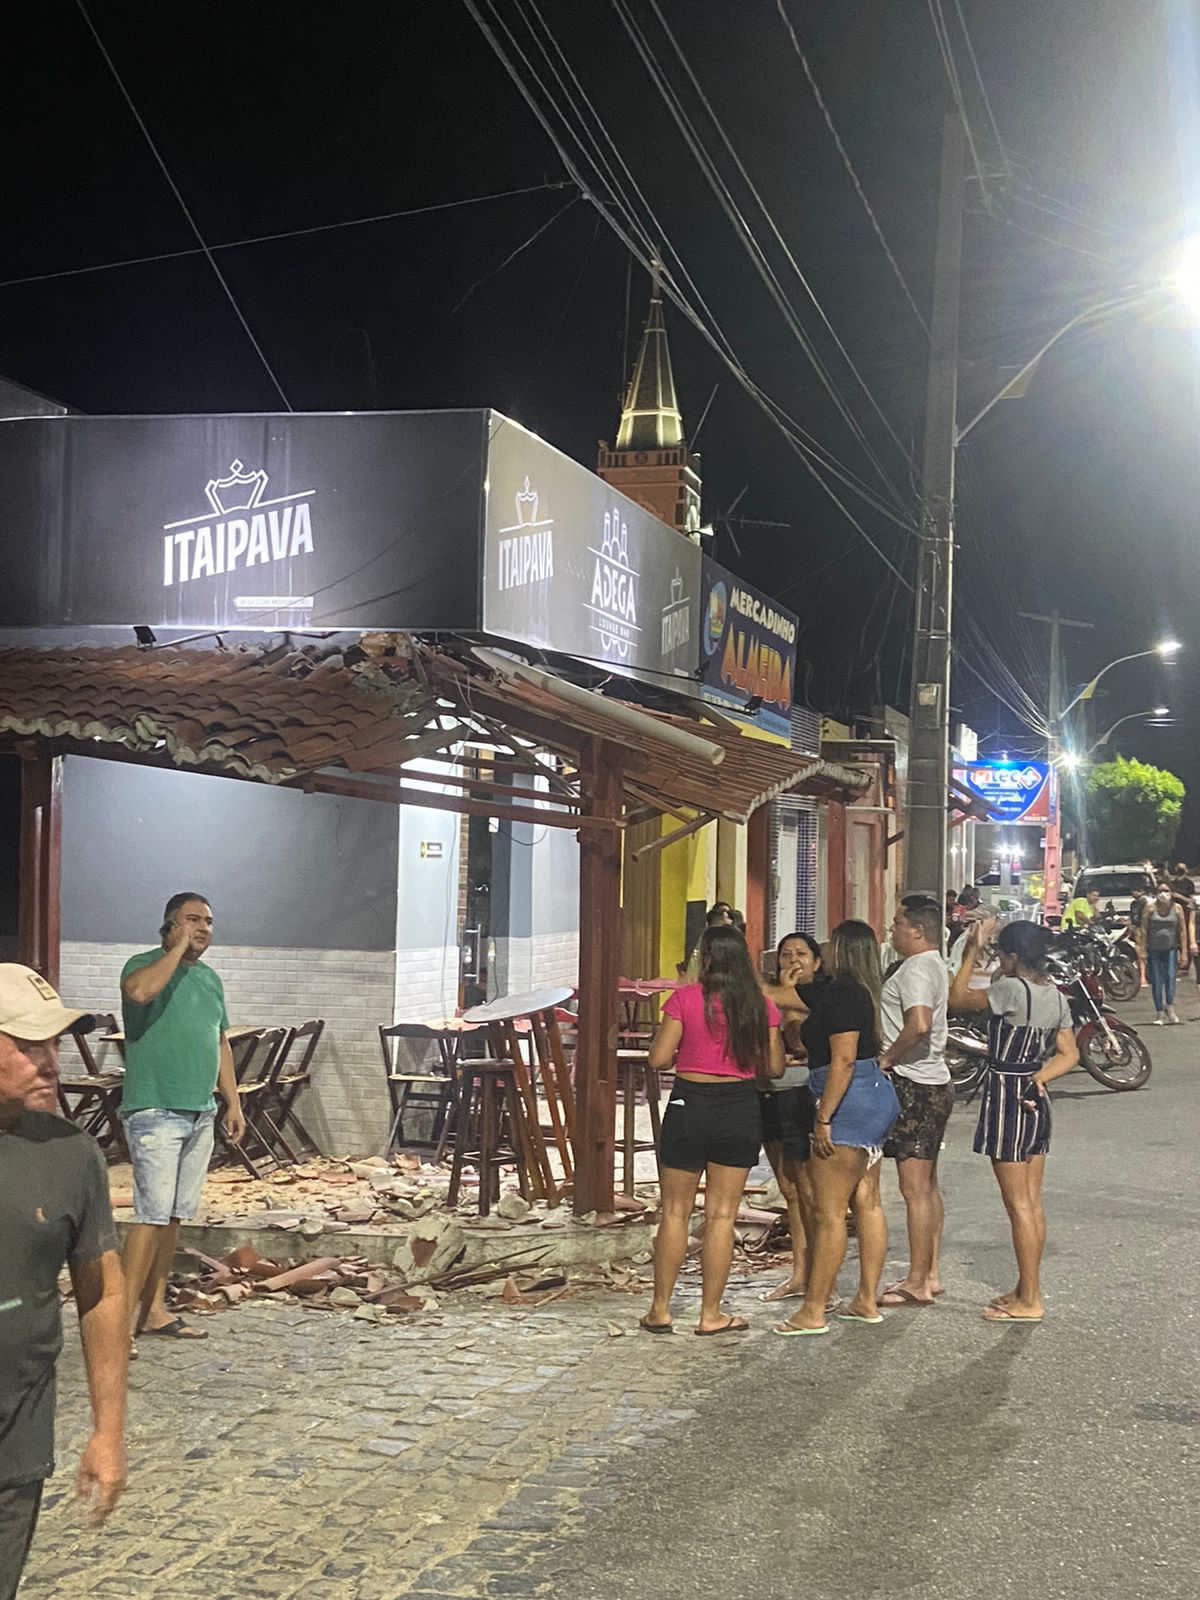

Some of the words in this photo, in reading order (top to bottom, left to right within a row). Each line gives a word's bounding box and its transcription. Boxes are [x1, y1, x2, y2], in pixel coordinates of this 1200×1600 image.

[163, 502, 314, 586] ITAIPAVA
[498, 530, 554, 591] ITAIPAVA
[591, 557, 637, 625] ADEGA
[730, 585, 796, 644] MERCADINHO
[720, 621, 792, 711] ALMEIDA
